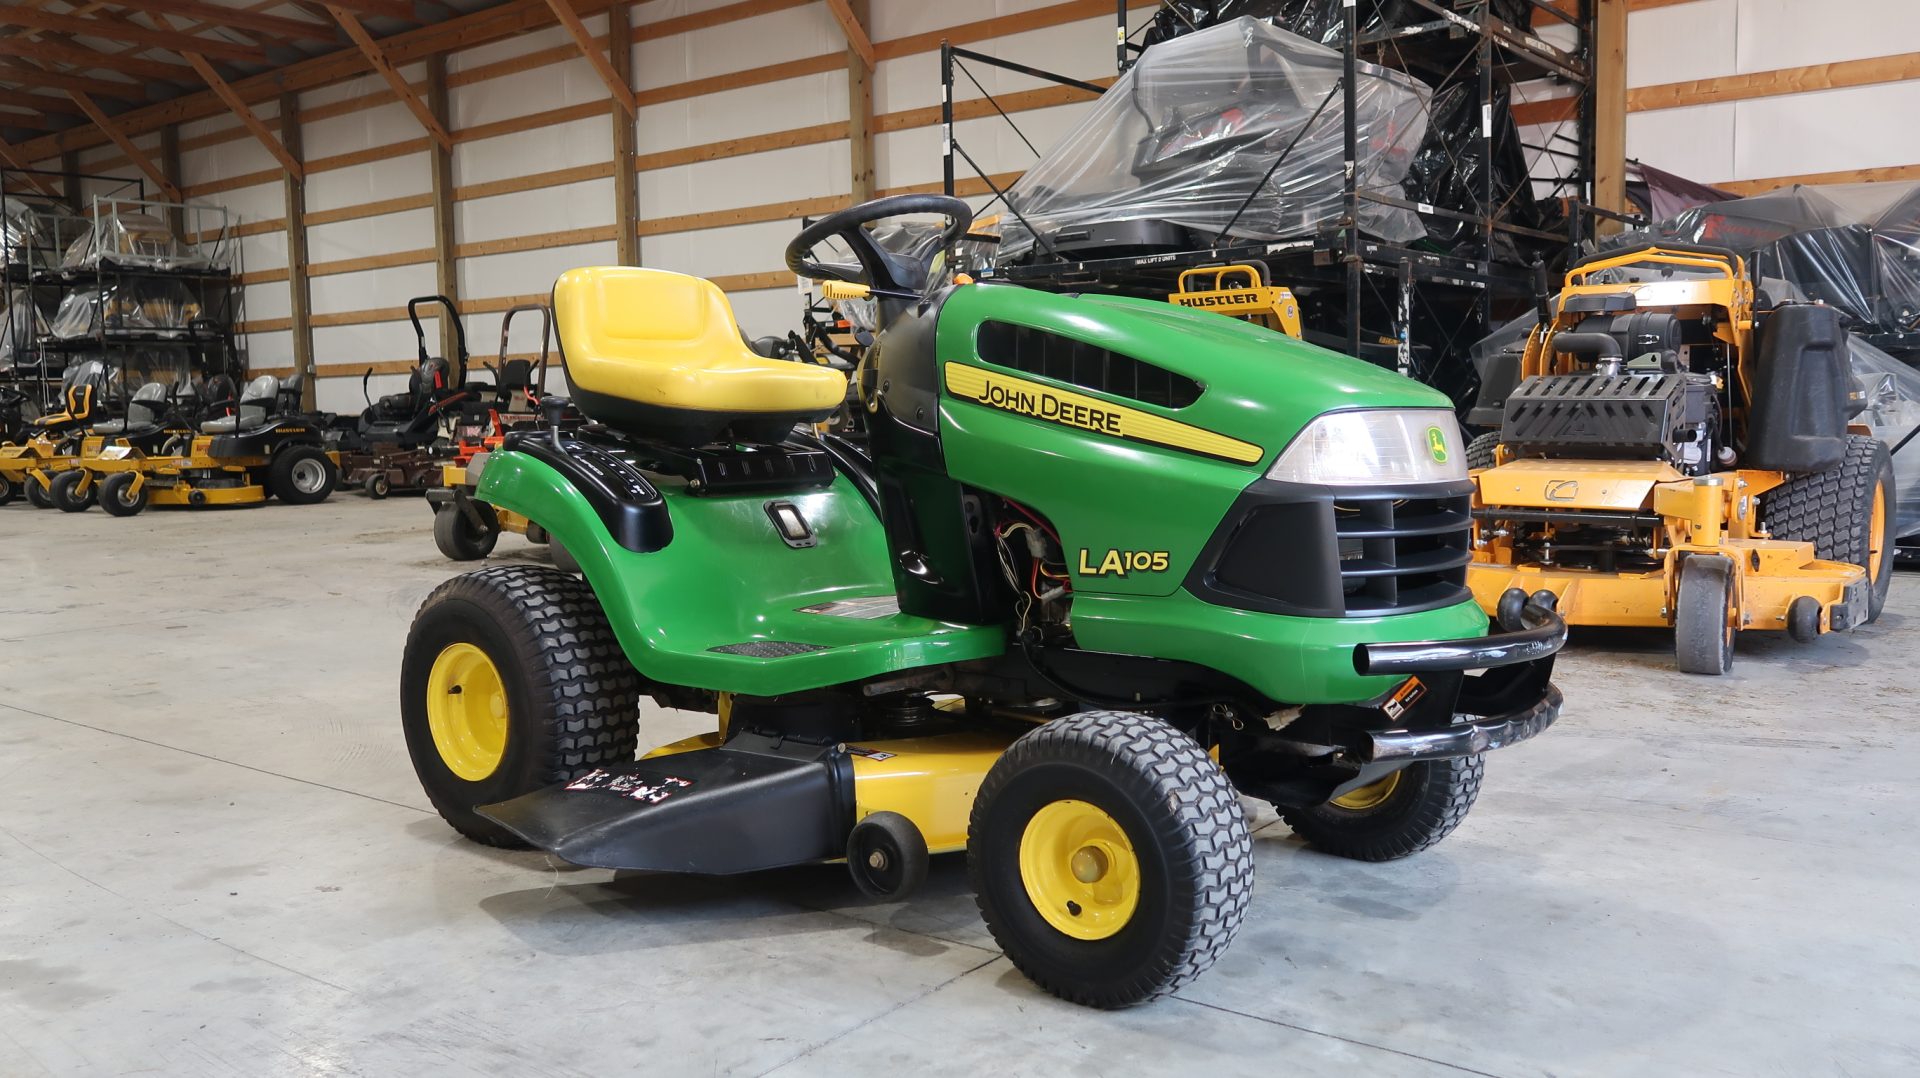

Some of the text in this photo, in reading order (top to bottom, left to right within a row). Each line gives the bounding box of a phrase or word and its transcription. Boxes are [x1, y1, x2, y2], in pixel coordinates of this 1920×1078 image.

[1179, 294, 1258, 307] HUSTLER
[978, 380, 1121, 433] JOHN DEERE
[1079, 548, 1170, 576] LA105
